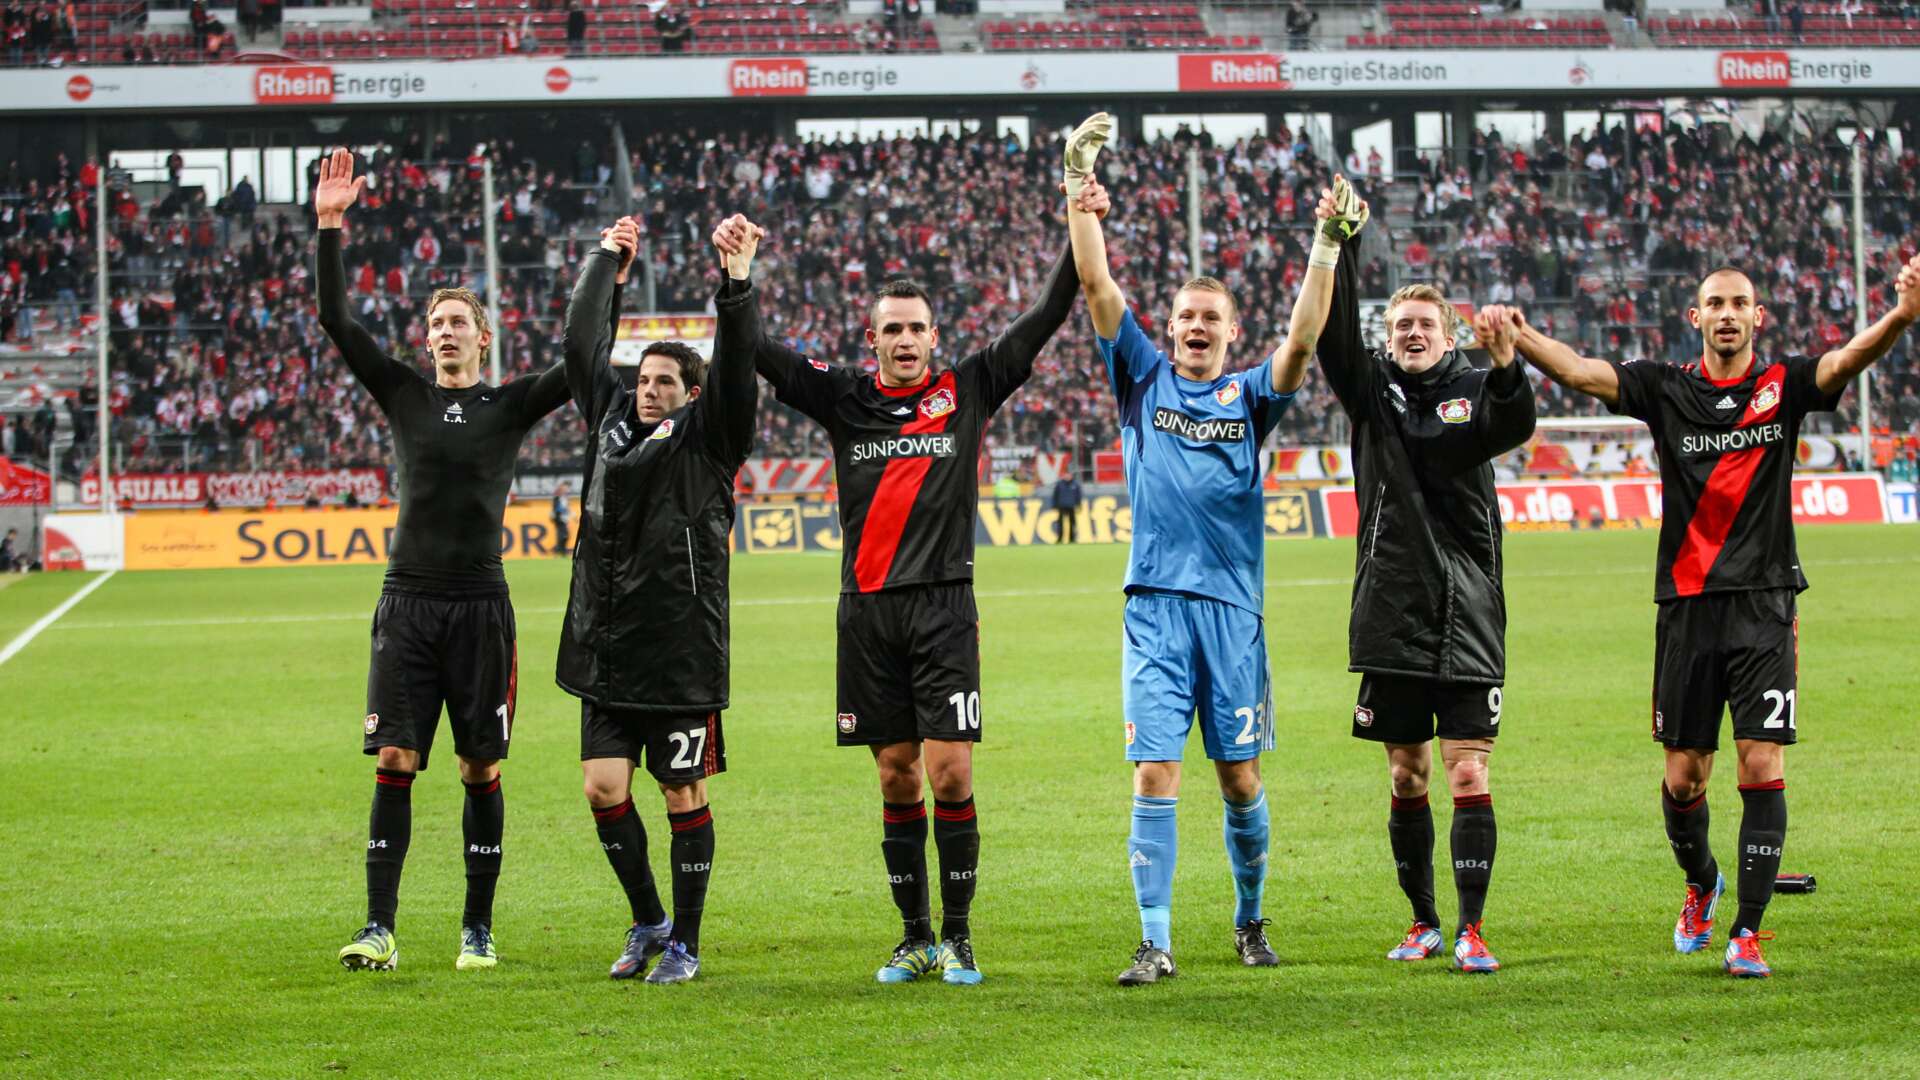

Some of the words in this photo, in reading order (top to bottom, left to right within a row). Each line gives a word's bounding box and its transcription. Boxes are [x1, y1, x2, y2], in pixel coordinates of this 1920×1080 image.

[258, 70, 425, 98] RheinEnergie
[734, 64, 898, 91] RheinEnergie
[1211, 60, 1447, 86] RheinEnergieStadion
[1721, 57, 1873, 83] RheinEnergie
[443, 413, 467, 424] L.A.
[1154, 410, 1245, 440] SUNPOWER
[853, 436, 953, 461] SUNPOWER
[1682, 423, 1784, 453] SUNPOWER
[949, 690, 981, 731] 10
[1487, 687, 1503, 726] 9
[1763, 689, 1797, 730] 21
[496, 703, 508, 741] 1
[1234, 702, 1265, 745] 23
[668, 727, 707, 769] 27
